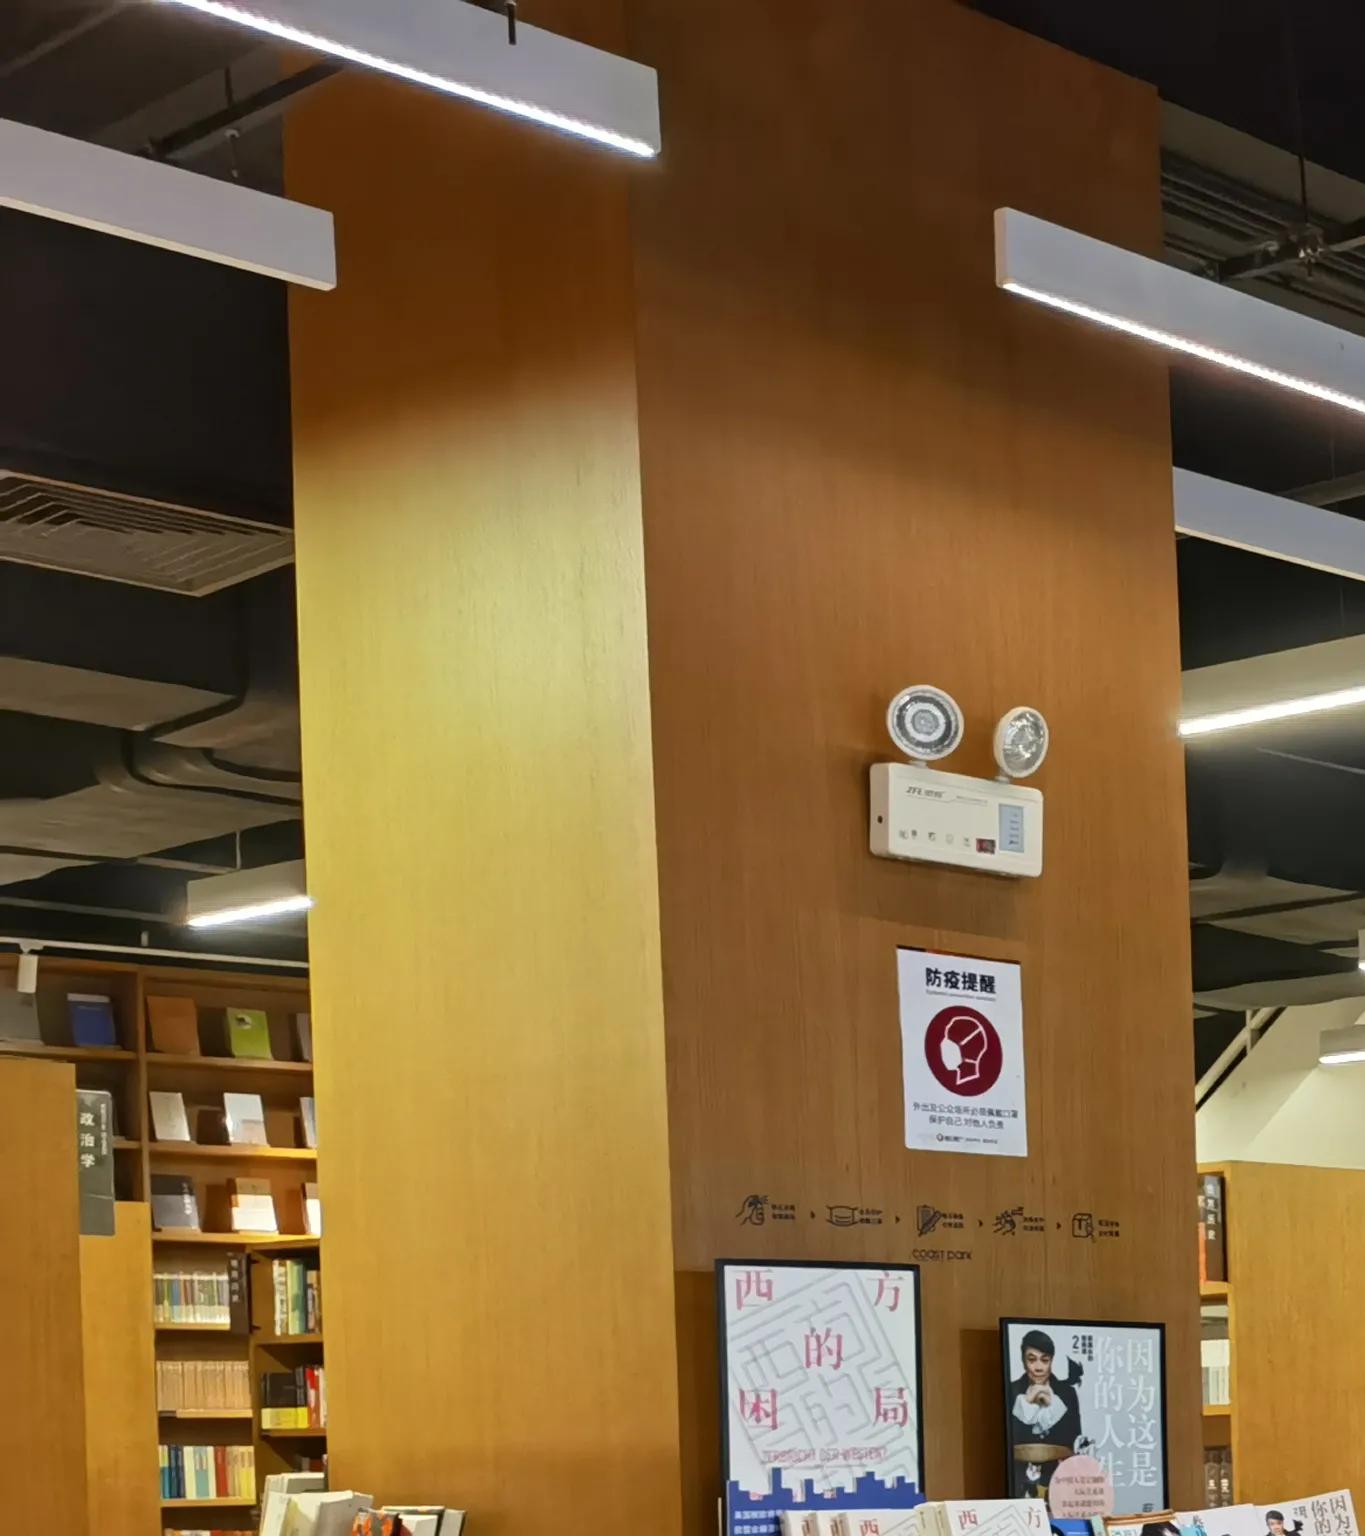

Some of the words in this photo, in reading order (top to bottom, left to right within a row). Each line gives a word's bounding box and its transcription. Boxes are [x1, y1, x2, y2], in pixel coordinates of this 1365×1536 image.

[925, 967, 996, 994] 防疫提醒
[80, 1112, 95, 1168] 政治学
[735, 1268, 774, 1311] 西
[871, 1271, 905, 1313] 方
[803, 1327, 844, 1371] 的
[739, 1387, 780, 1431] 困
[871, 1387, 909, 1429] 局
[1093, 1335, 1126, 1487] 你的人生
[1126, 1338, 1158, 1487] 因为这是
[958, 1507, 979, 1529] 西
[1027, 1507, 1043, 1529] 方
